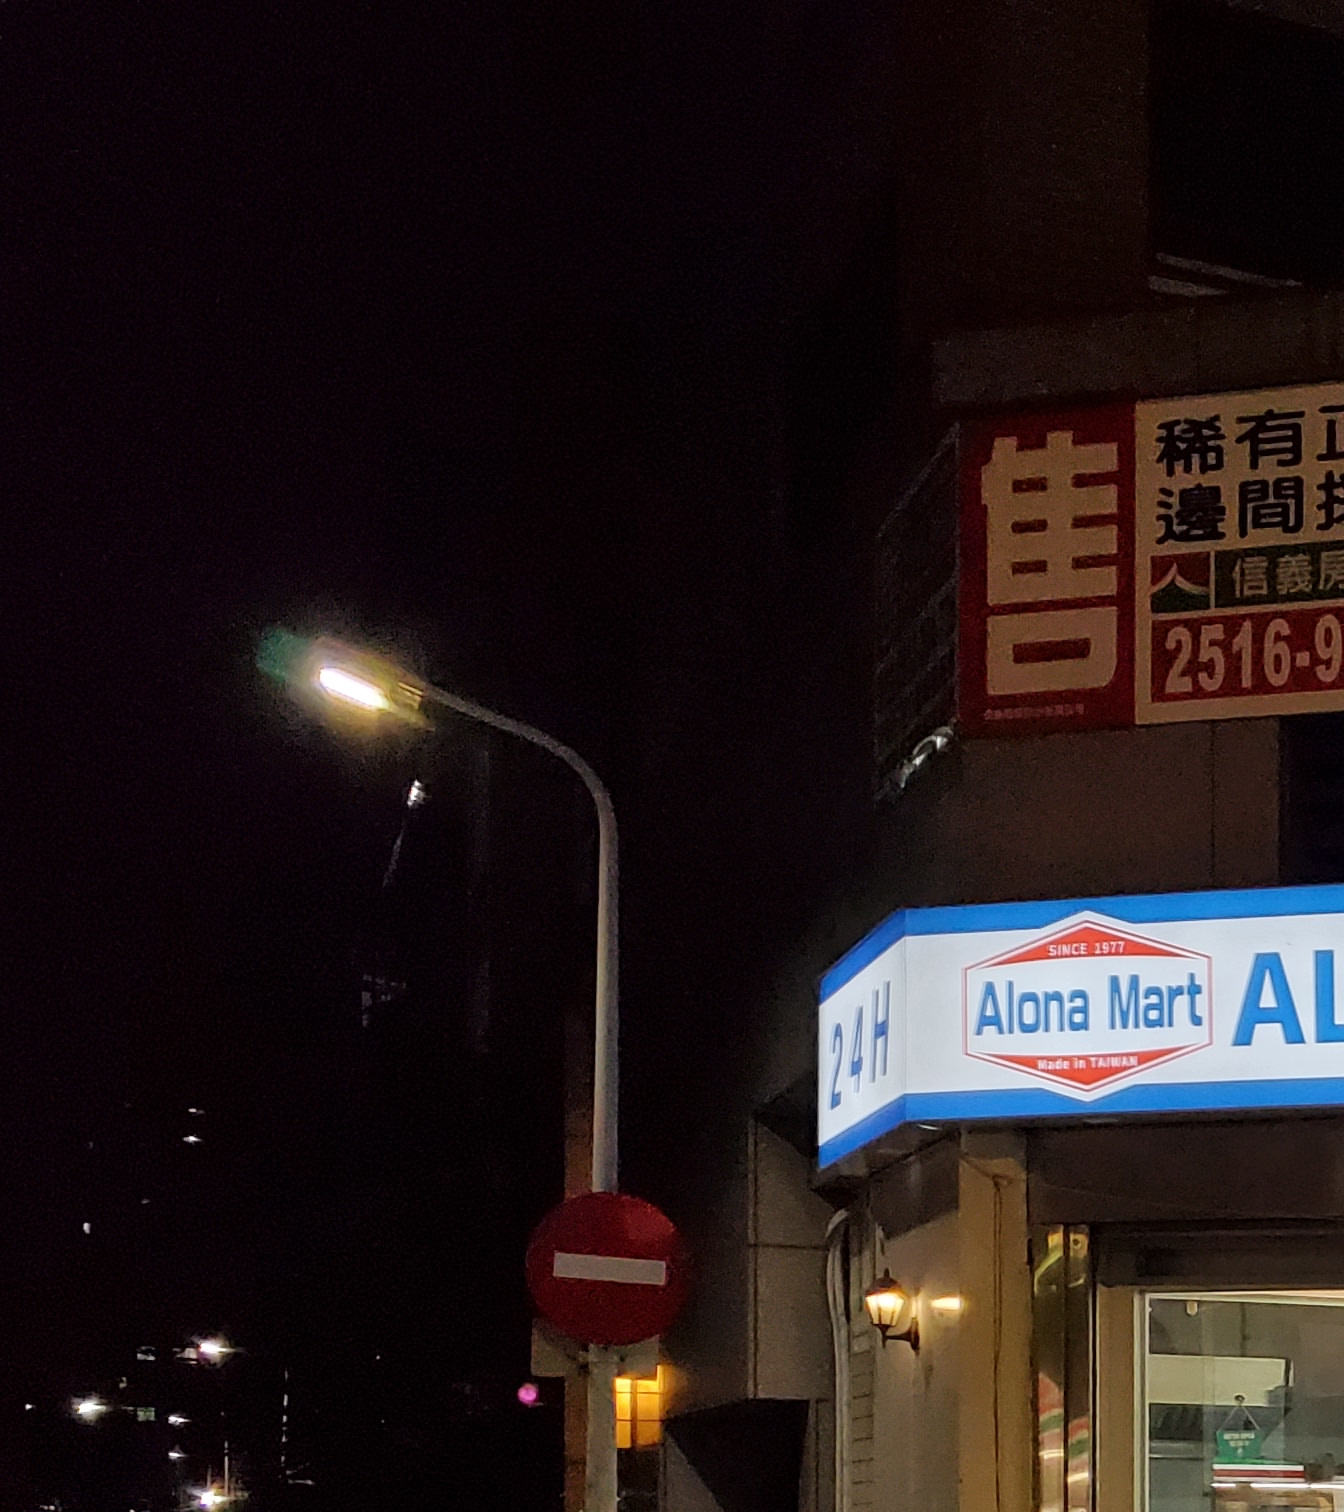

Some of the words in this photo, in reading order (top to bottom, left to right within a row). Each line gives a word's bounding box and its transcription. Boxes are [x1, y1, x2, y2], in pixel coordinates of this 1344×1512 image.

[981, 430, 1118, 695] 售
[1048, 942, 1088, 957] SINCE
[1094, 940, 1125, 955] 1977
[974, 979, 1091, 1036] Alona
[1108, 972, 1203, 1030] Mart
[829, 979, 891, 1111] 24H
[1037, 1058, 1070, 1071] Made
[1089, 1055, 1139, 1069] TAIWAN
